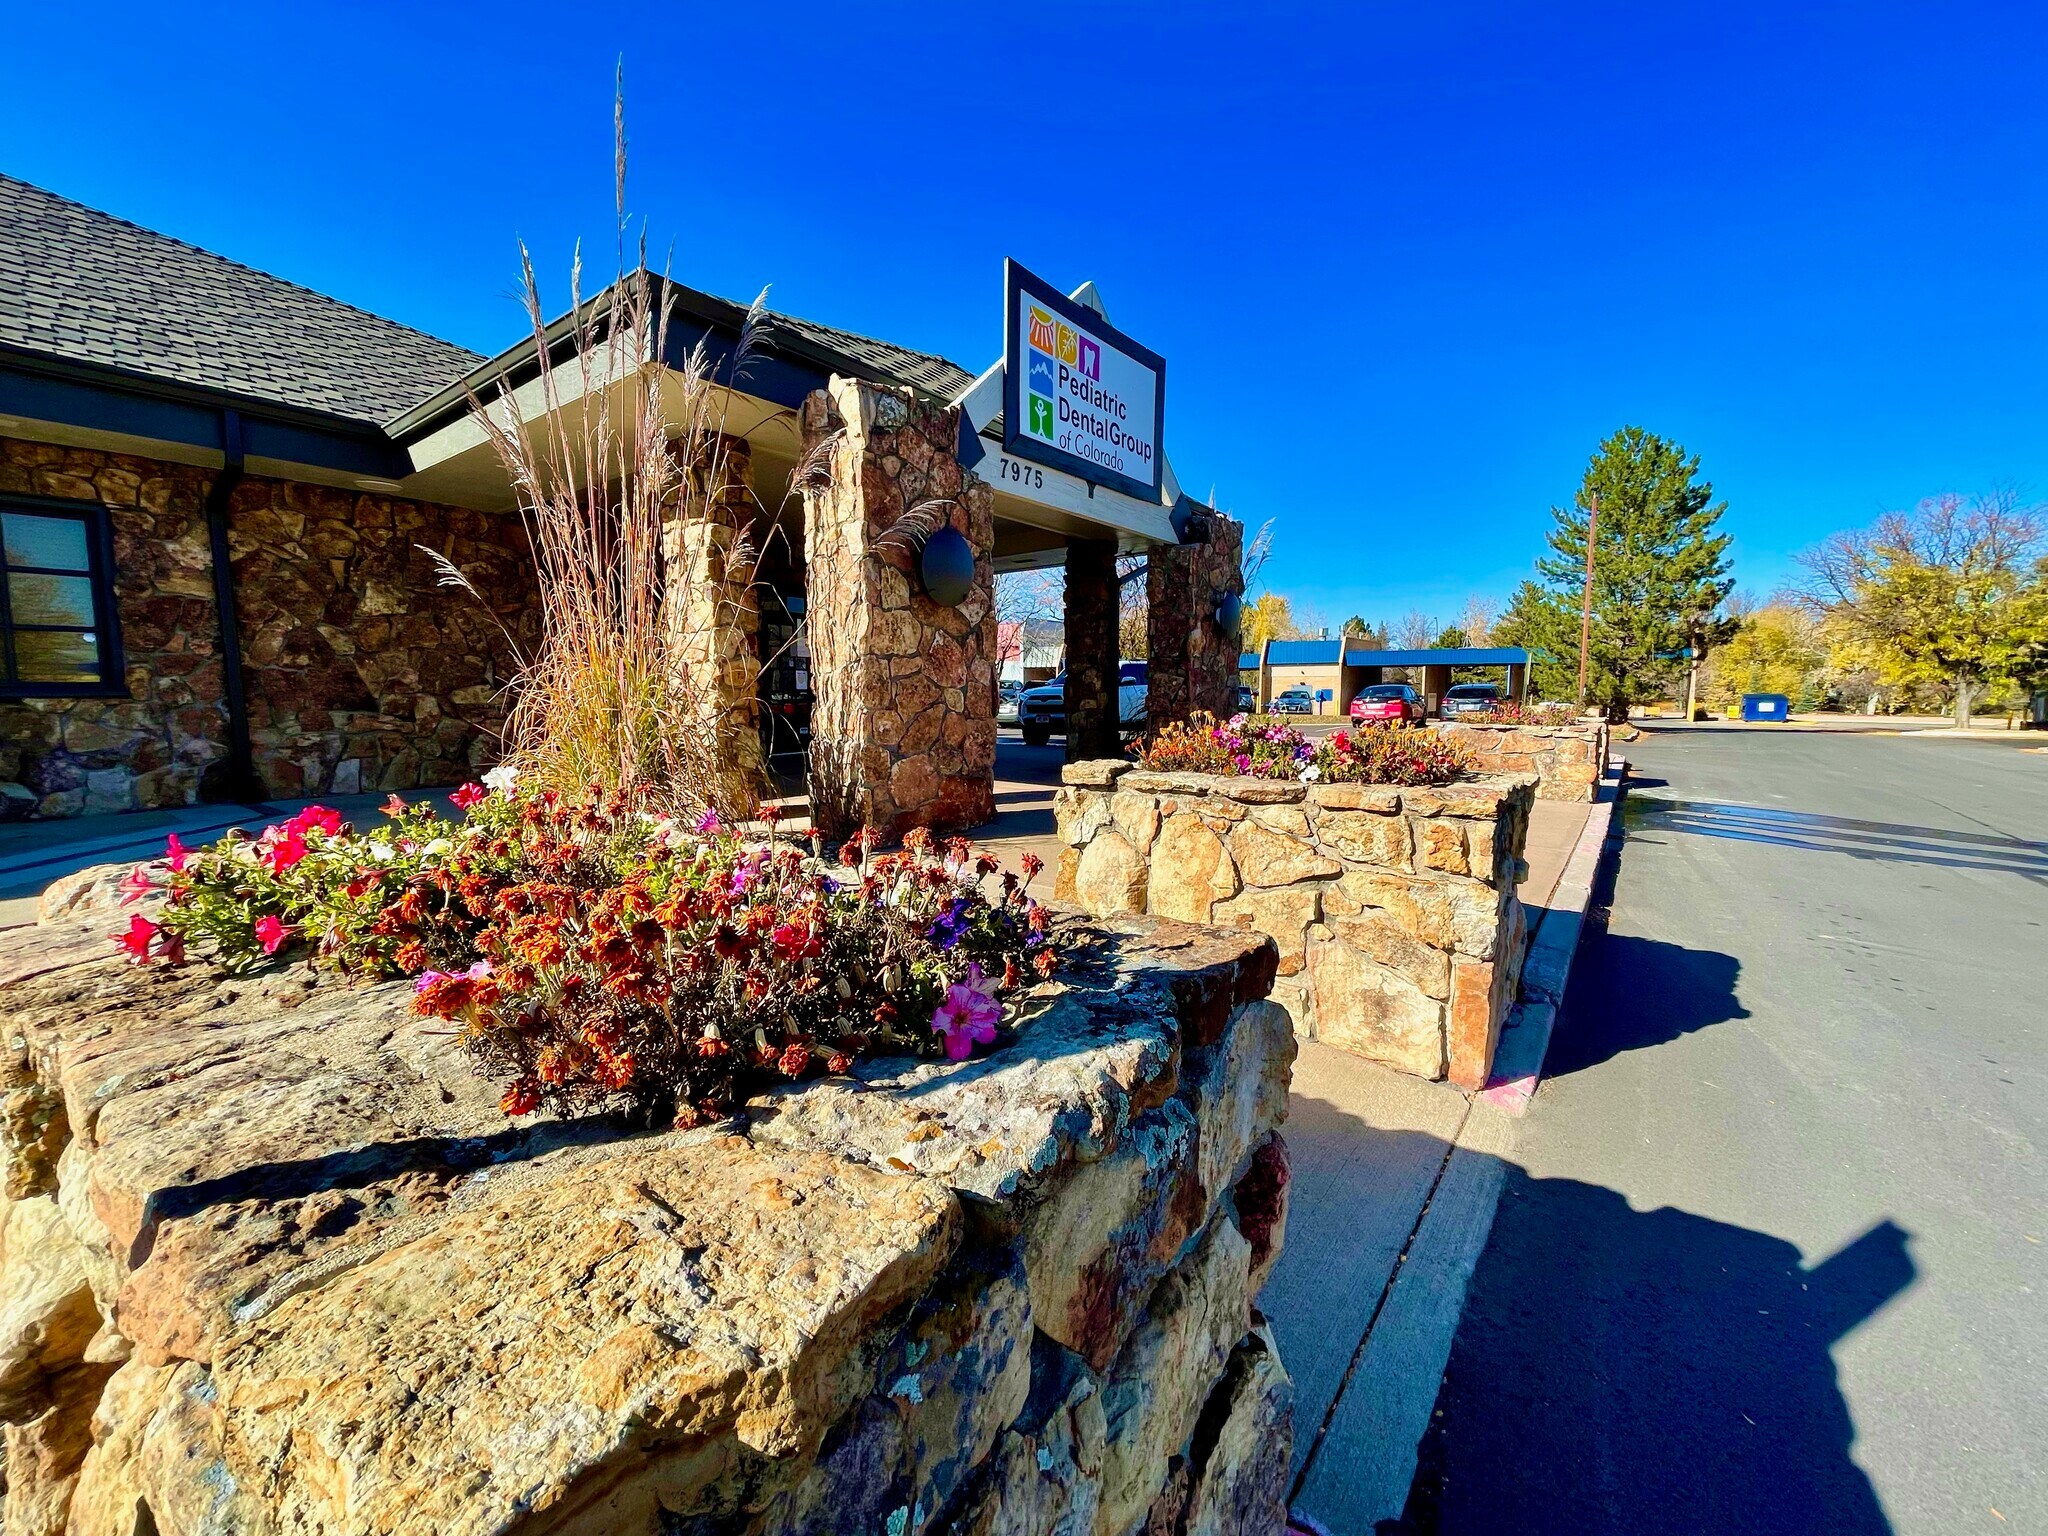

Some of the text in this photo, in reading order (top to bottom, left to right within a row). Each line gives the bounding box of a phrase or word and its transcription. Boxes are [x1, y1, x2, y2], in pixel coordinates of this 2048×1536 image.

[1059, 363, 1126, 420] Pediatric
[1059, 431, 1123, 471] of Colorado
[1000, 458, 1043, 489] 7975
